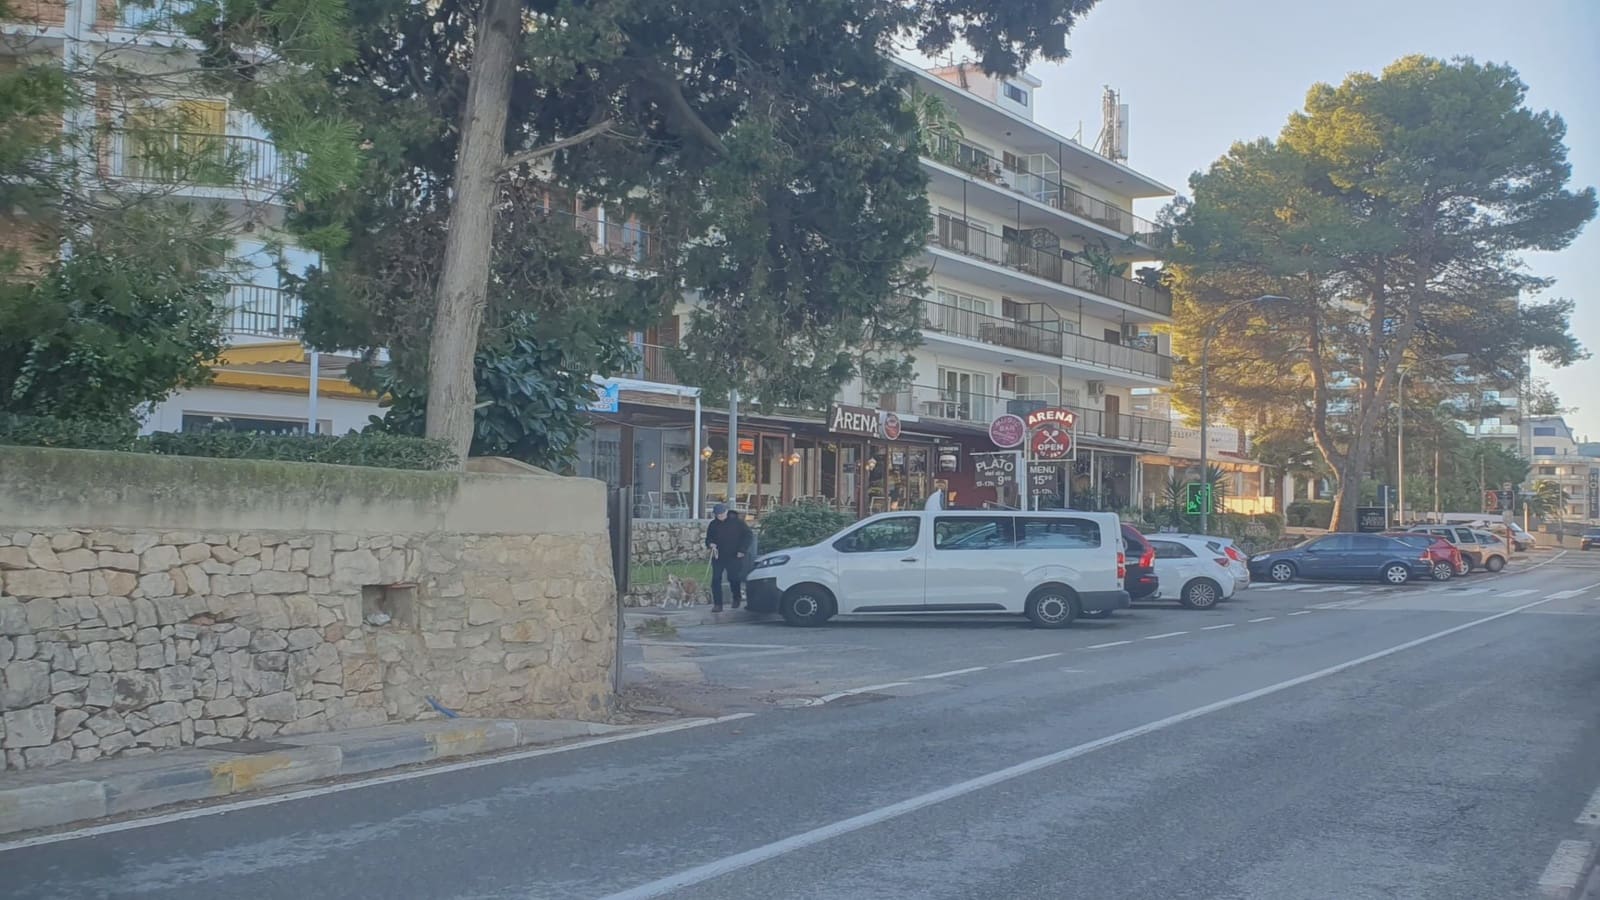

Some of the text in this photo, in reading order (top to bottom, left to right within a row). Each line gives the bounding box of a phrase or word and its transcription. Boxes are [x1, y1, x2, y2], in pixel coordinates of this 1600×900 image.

[834, 407, 878, 432] ARENA
[1029, 410, 1073, 424] ARENA
[1038, 443, 1063, 451] OPEN
[976, 459, 1014, 472] PLATO
[1590, 474, 1598, 511] HOTEL
